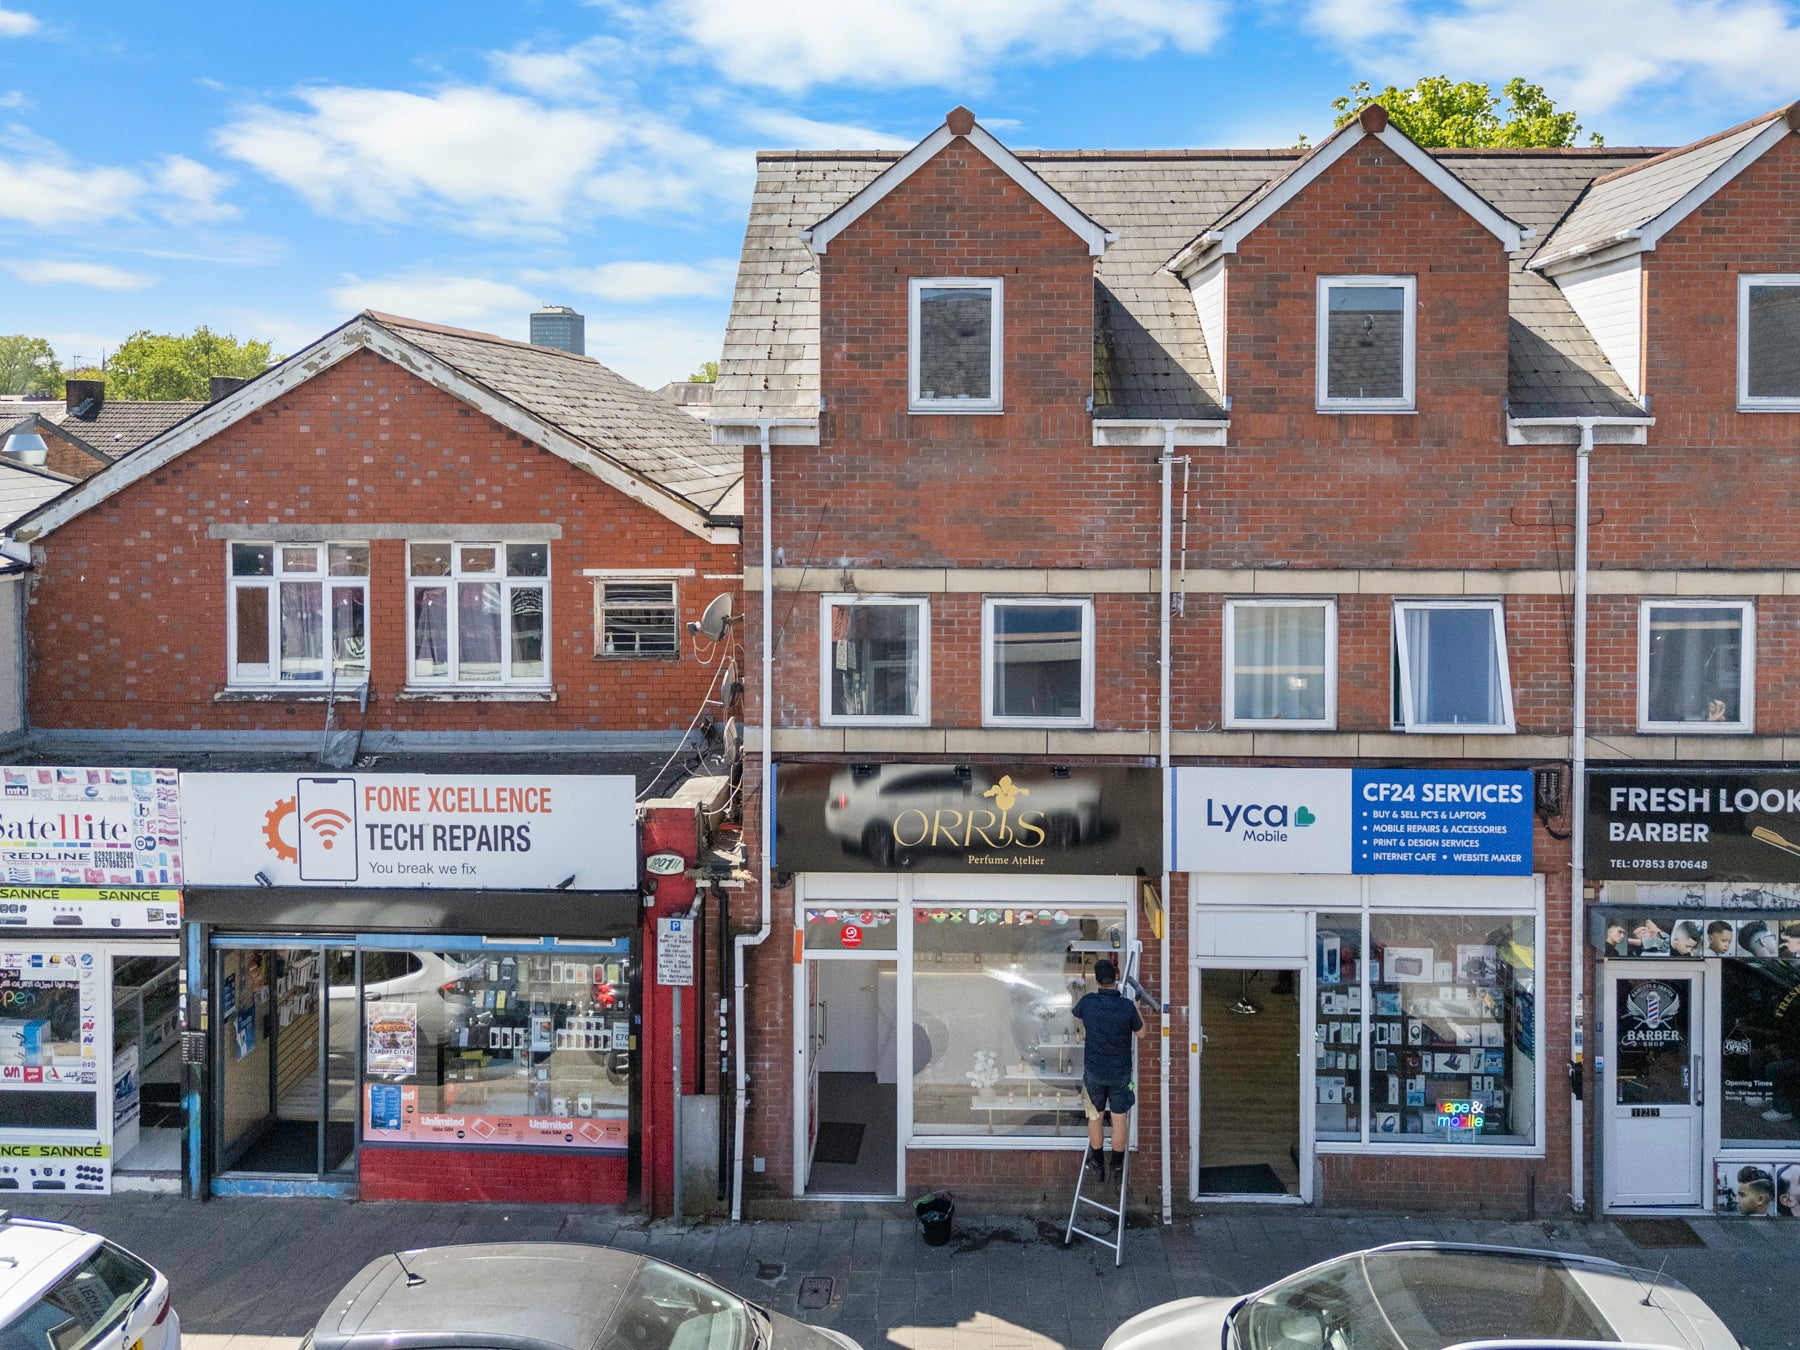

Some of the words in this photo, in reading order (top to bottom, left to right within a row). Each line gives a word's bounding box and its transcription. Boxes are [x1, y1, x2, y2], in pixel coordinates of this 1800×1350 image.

[365, 786, 421, 812] FONE
[428, 787, 552, 813] XCELLENCE
[1363, 783, 1416, 802] CF24
[1421, 784, 1523, 804] SERVICES
[1610, 787, 1710, 812] FRESH
[1206, 798, 1288, 833] Lyca
[1373, 811, 1391, 819] BUY
[1392, 811, 1399, 819] &
[1400, 811, 1420, 819] SELL
[1421, 811, 1439, 819] PC'S
[1449, 811, 1487, 820] LAPTOPS
[893, 809, 1045, 849] ORRIS
[1373, 825, 1405, 833] MOBILE
[1406, 825, 1441, 833] REPAIRS
[1450, 825, 1508, 834] ACCESSORIES
[1609, 822, 1709, 842] BARBER
[365, 823, 424, 851] TECH
[433, 824, 532, 852] REPAIRS
[1242, 830, 1288, 843] Mobile
[1373, 838, 1398, 847] PRINT
[1399, 839, 1406, 847] &
[1407, 839, 1439, 847] DESIGN
[1441, 839, 1480, 848] SERVICES
[2, 851, 90, 861] REDLINE
[968, 855, 1009, 865] Perfume
[1011, 856, 1045, 866] Atelier
[1373, 852, 1413, 861] INTERNET
[1414, 853, 1437, 861] CAFE
[1453, 853, 1490, 862] WEBSITE
[1490, 853, 1522, 862] MAKER
[368, 861, 393, 874] You
[397, 862, 435, 875] break
[438, 866, 458, 875] we
[462, 862, 477, 875] fix
[1610, 859, 1631, 868] TEL:
[1632, 860, 1665, 869] 07853
[1667, 860, 1708, 869] 870648
[0, 888, 60, 900] SANNCE
[98, 890, 160, 901] SANNCE
[672, 921, 680, 931] P
[0, 990, 36, 1008] pen
[1628, 1030, 1680, 1041] BARBER
[1437, 1102, 1470, 1116] vape
[1471, 1100, 1484, 1114] &
[421, 1115, 465, 1127] Unlimited
[529, 1119, 574, 1130] Unlimited
[1437, 1114, 1484, 1127] mobile
[40, 1146, 102, 1157] SANNCE
